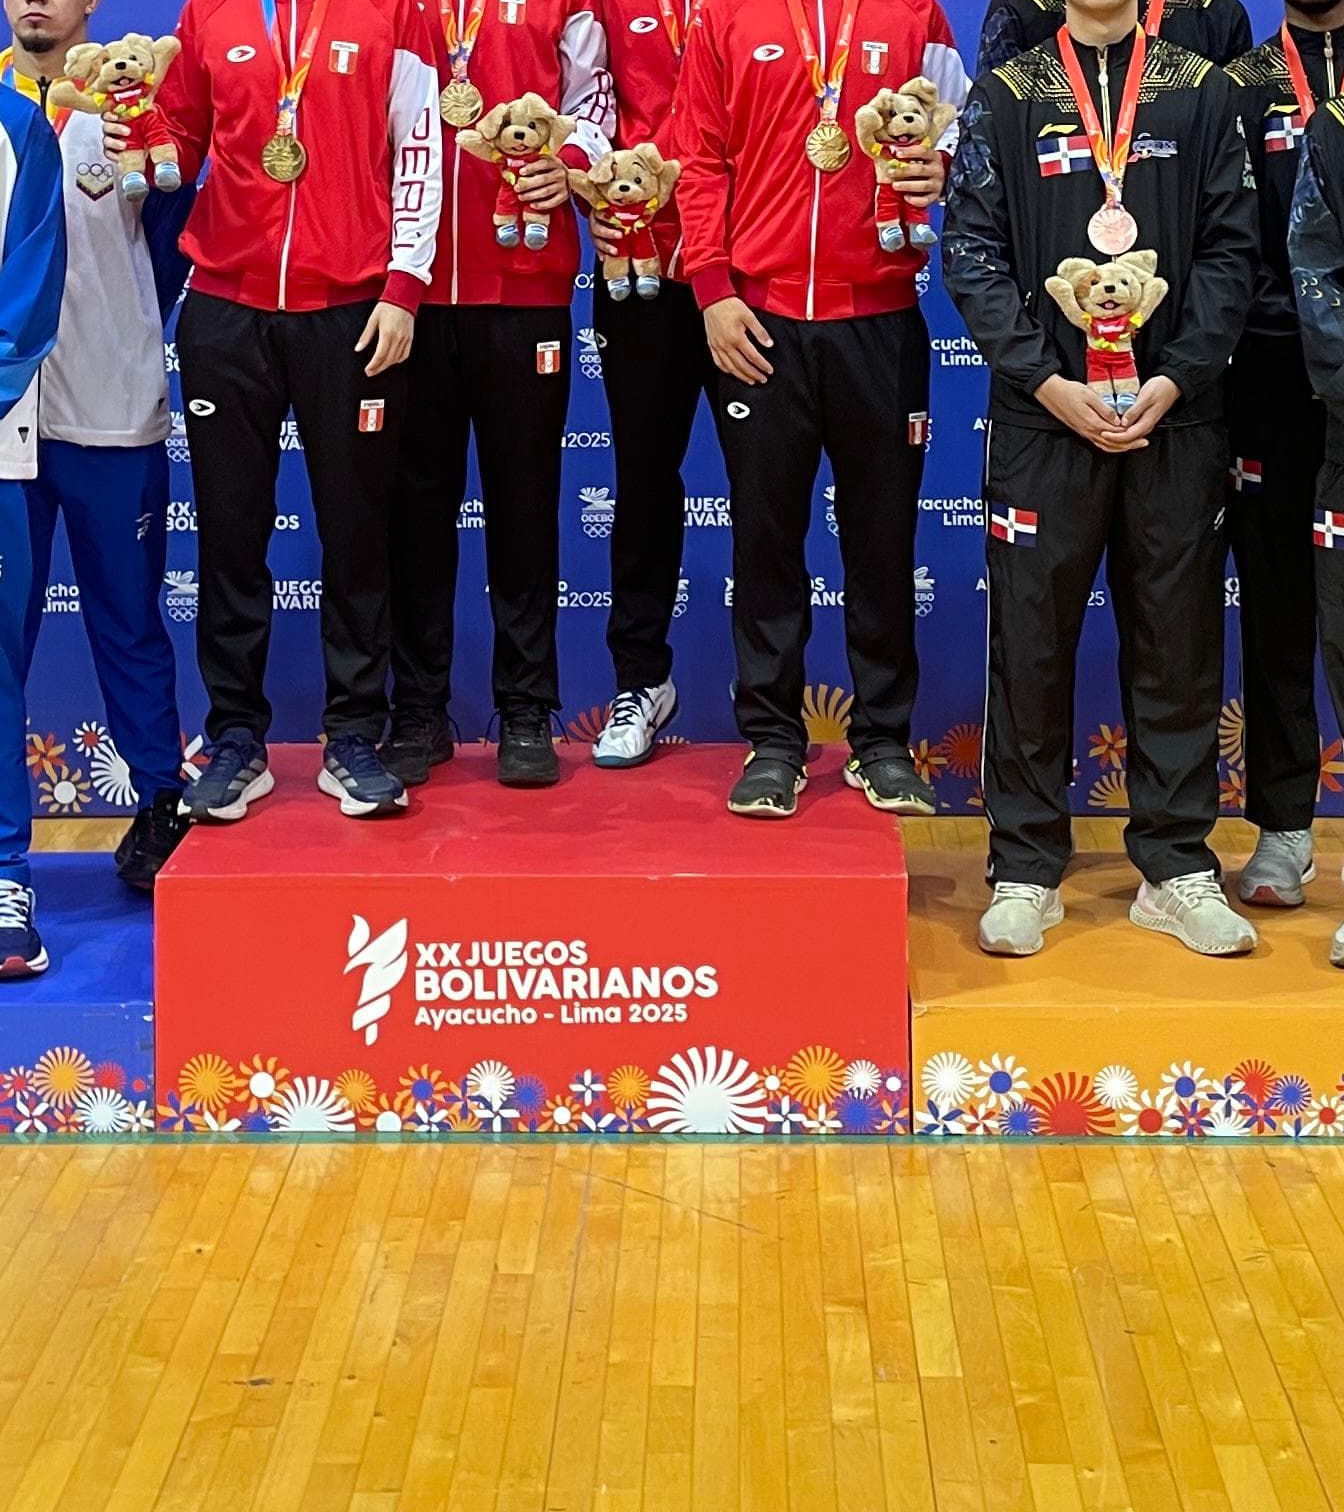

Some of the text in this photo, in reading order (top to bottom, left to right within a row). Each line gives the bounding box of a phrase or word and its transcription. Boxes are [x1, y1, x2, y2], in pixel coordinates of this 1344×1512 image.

[415, 940, 588, 967] XX JUEGOS
[415, 965, 719, 1001] BOLIVARIANOS
[415, 1003, 538, 1031] Ayacucho
[560, 1002, 622, 1025] Lima
[628, 1003, 688, 1024] 2025
